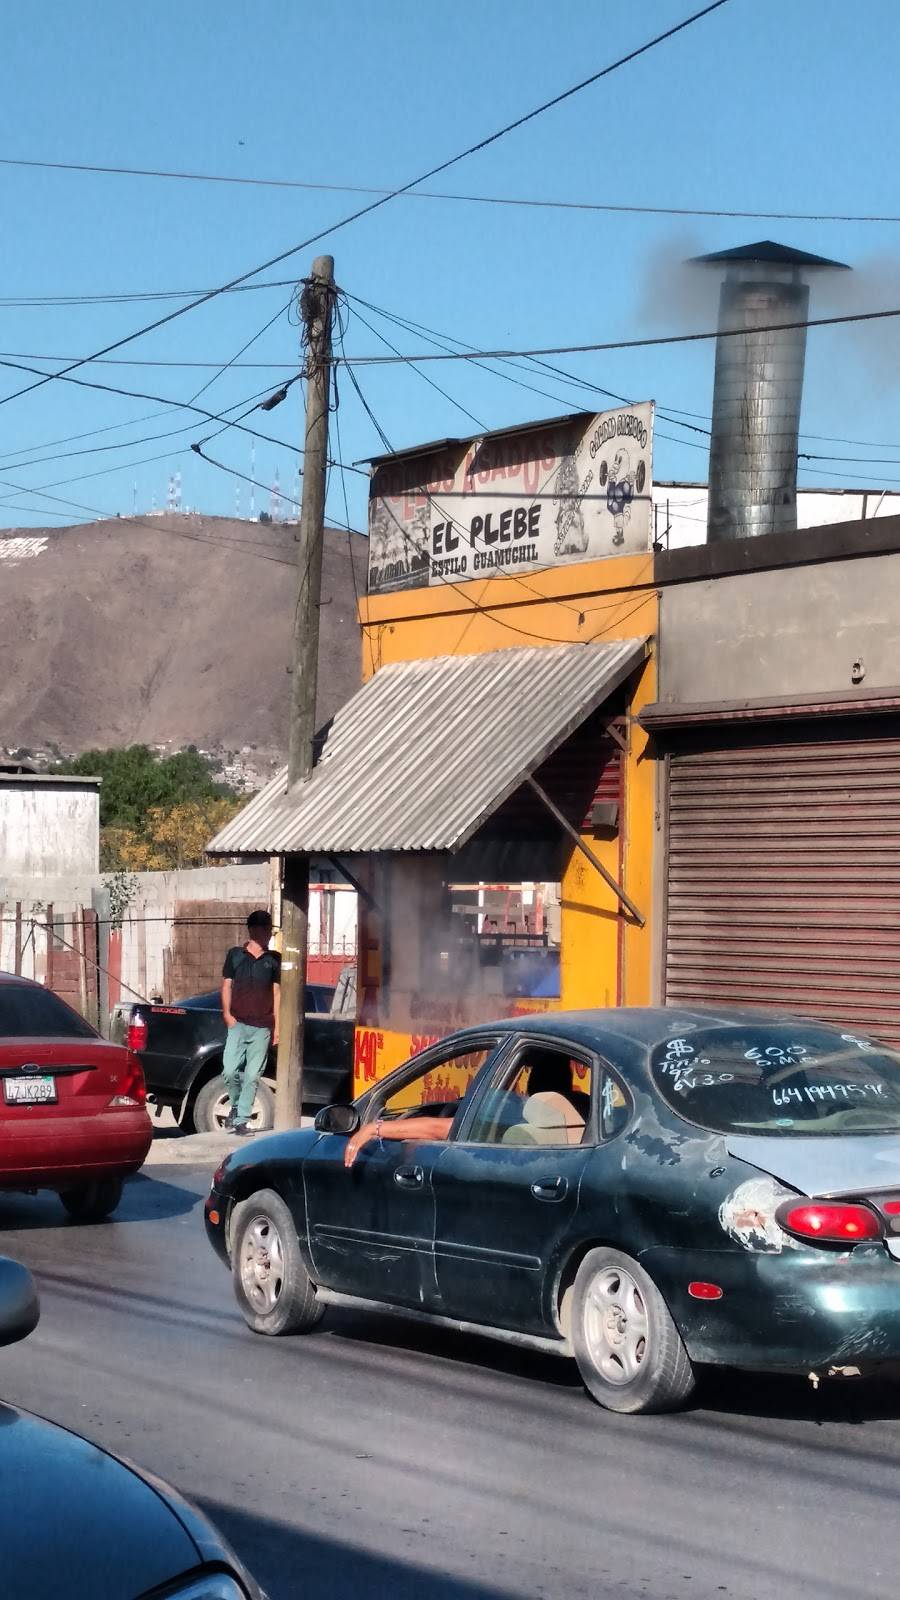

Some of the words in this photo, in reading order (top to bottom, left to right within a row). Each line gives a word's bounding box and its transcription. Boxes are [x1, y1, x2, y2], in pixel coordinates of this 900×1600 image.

[617, 414, 647, 449] BACHOCO
[462, 436, 555, 498] ASADOS
[433, 521, 459, 555] EL
[470, 504, 541, 548] PLEBE
[431, 556, 467, 577] ESTILO
[474, 544, 538, 570] GUAMUCHIL
